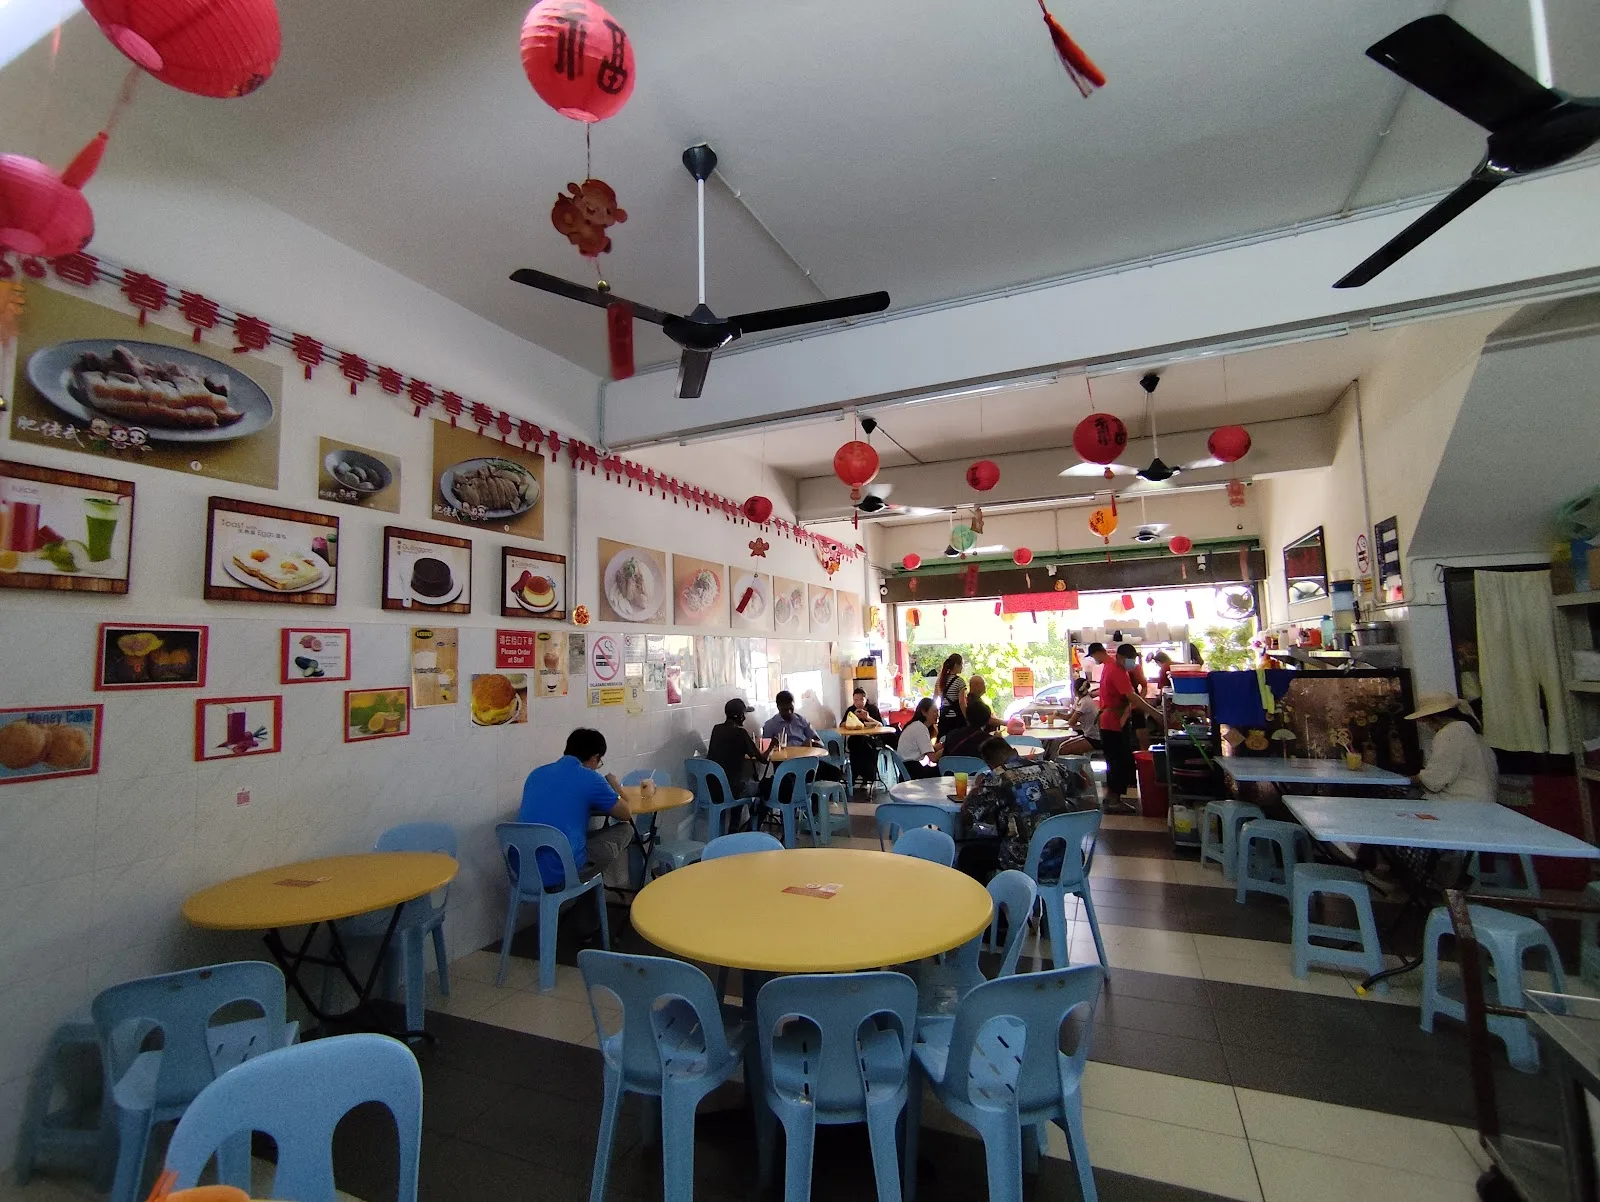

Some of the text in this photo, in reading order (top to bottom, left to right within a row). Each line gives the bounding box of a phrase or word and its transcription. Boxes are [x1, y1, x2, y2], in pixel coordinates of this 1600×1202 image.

[221, 519, 244, 529] Toast
[257, 530, 274, 539] Eggs
[514, 656, 525, 664] Stall
[27, 709, 93, 725] Honey Cake
